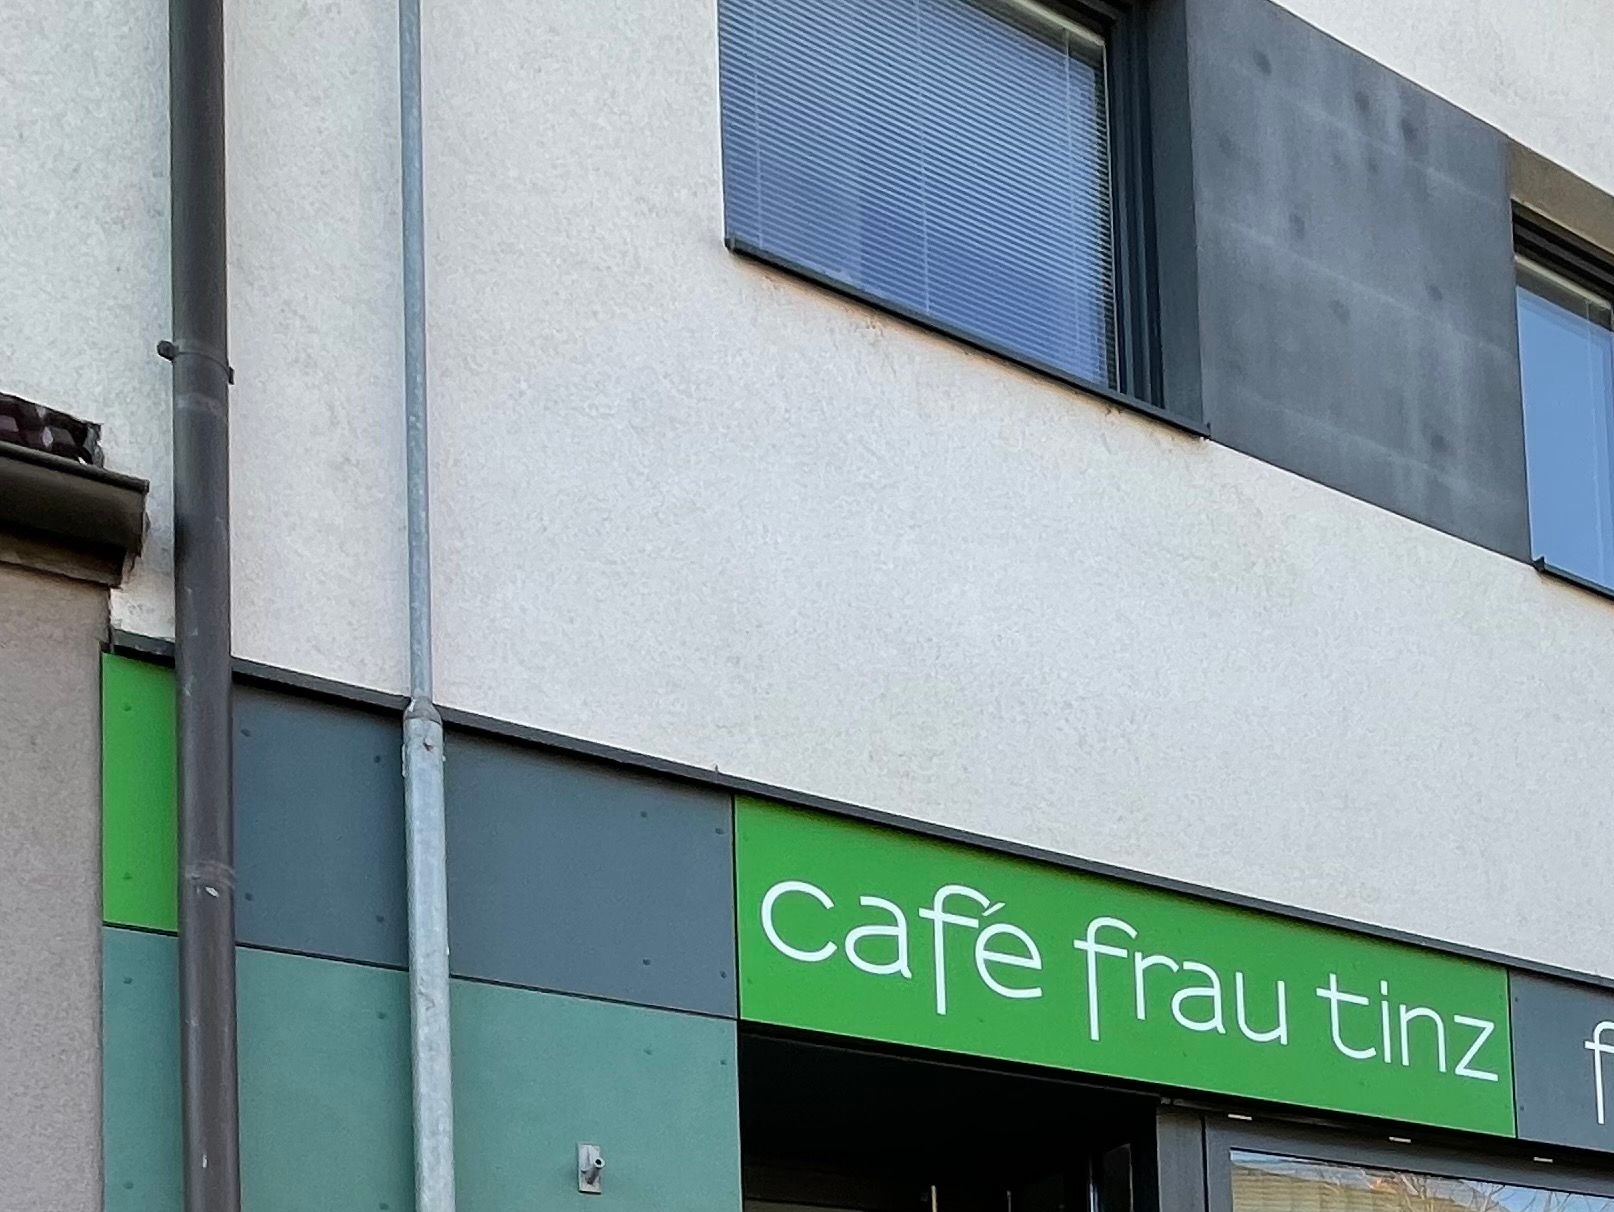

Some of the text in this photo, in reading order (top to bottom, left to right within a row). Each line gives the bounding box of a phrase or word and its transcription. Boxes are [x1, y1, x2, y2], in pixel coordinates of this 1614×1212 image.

[760, 880, 1499, 1082] café frau tinz
